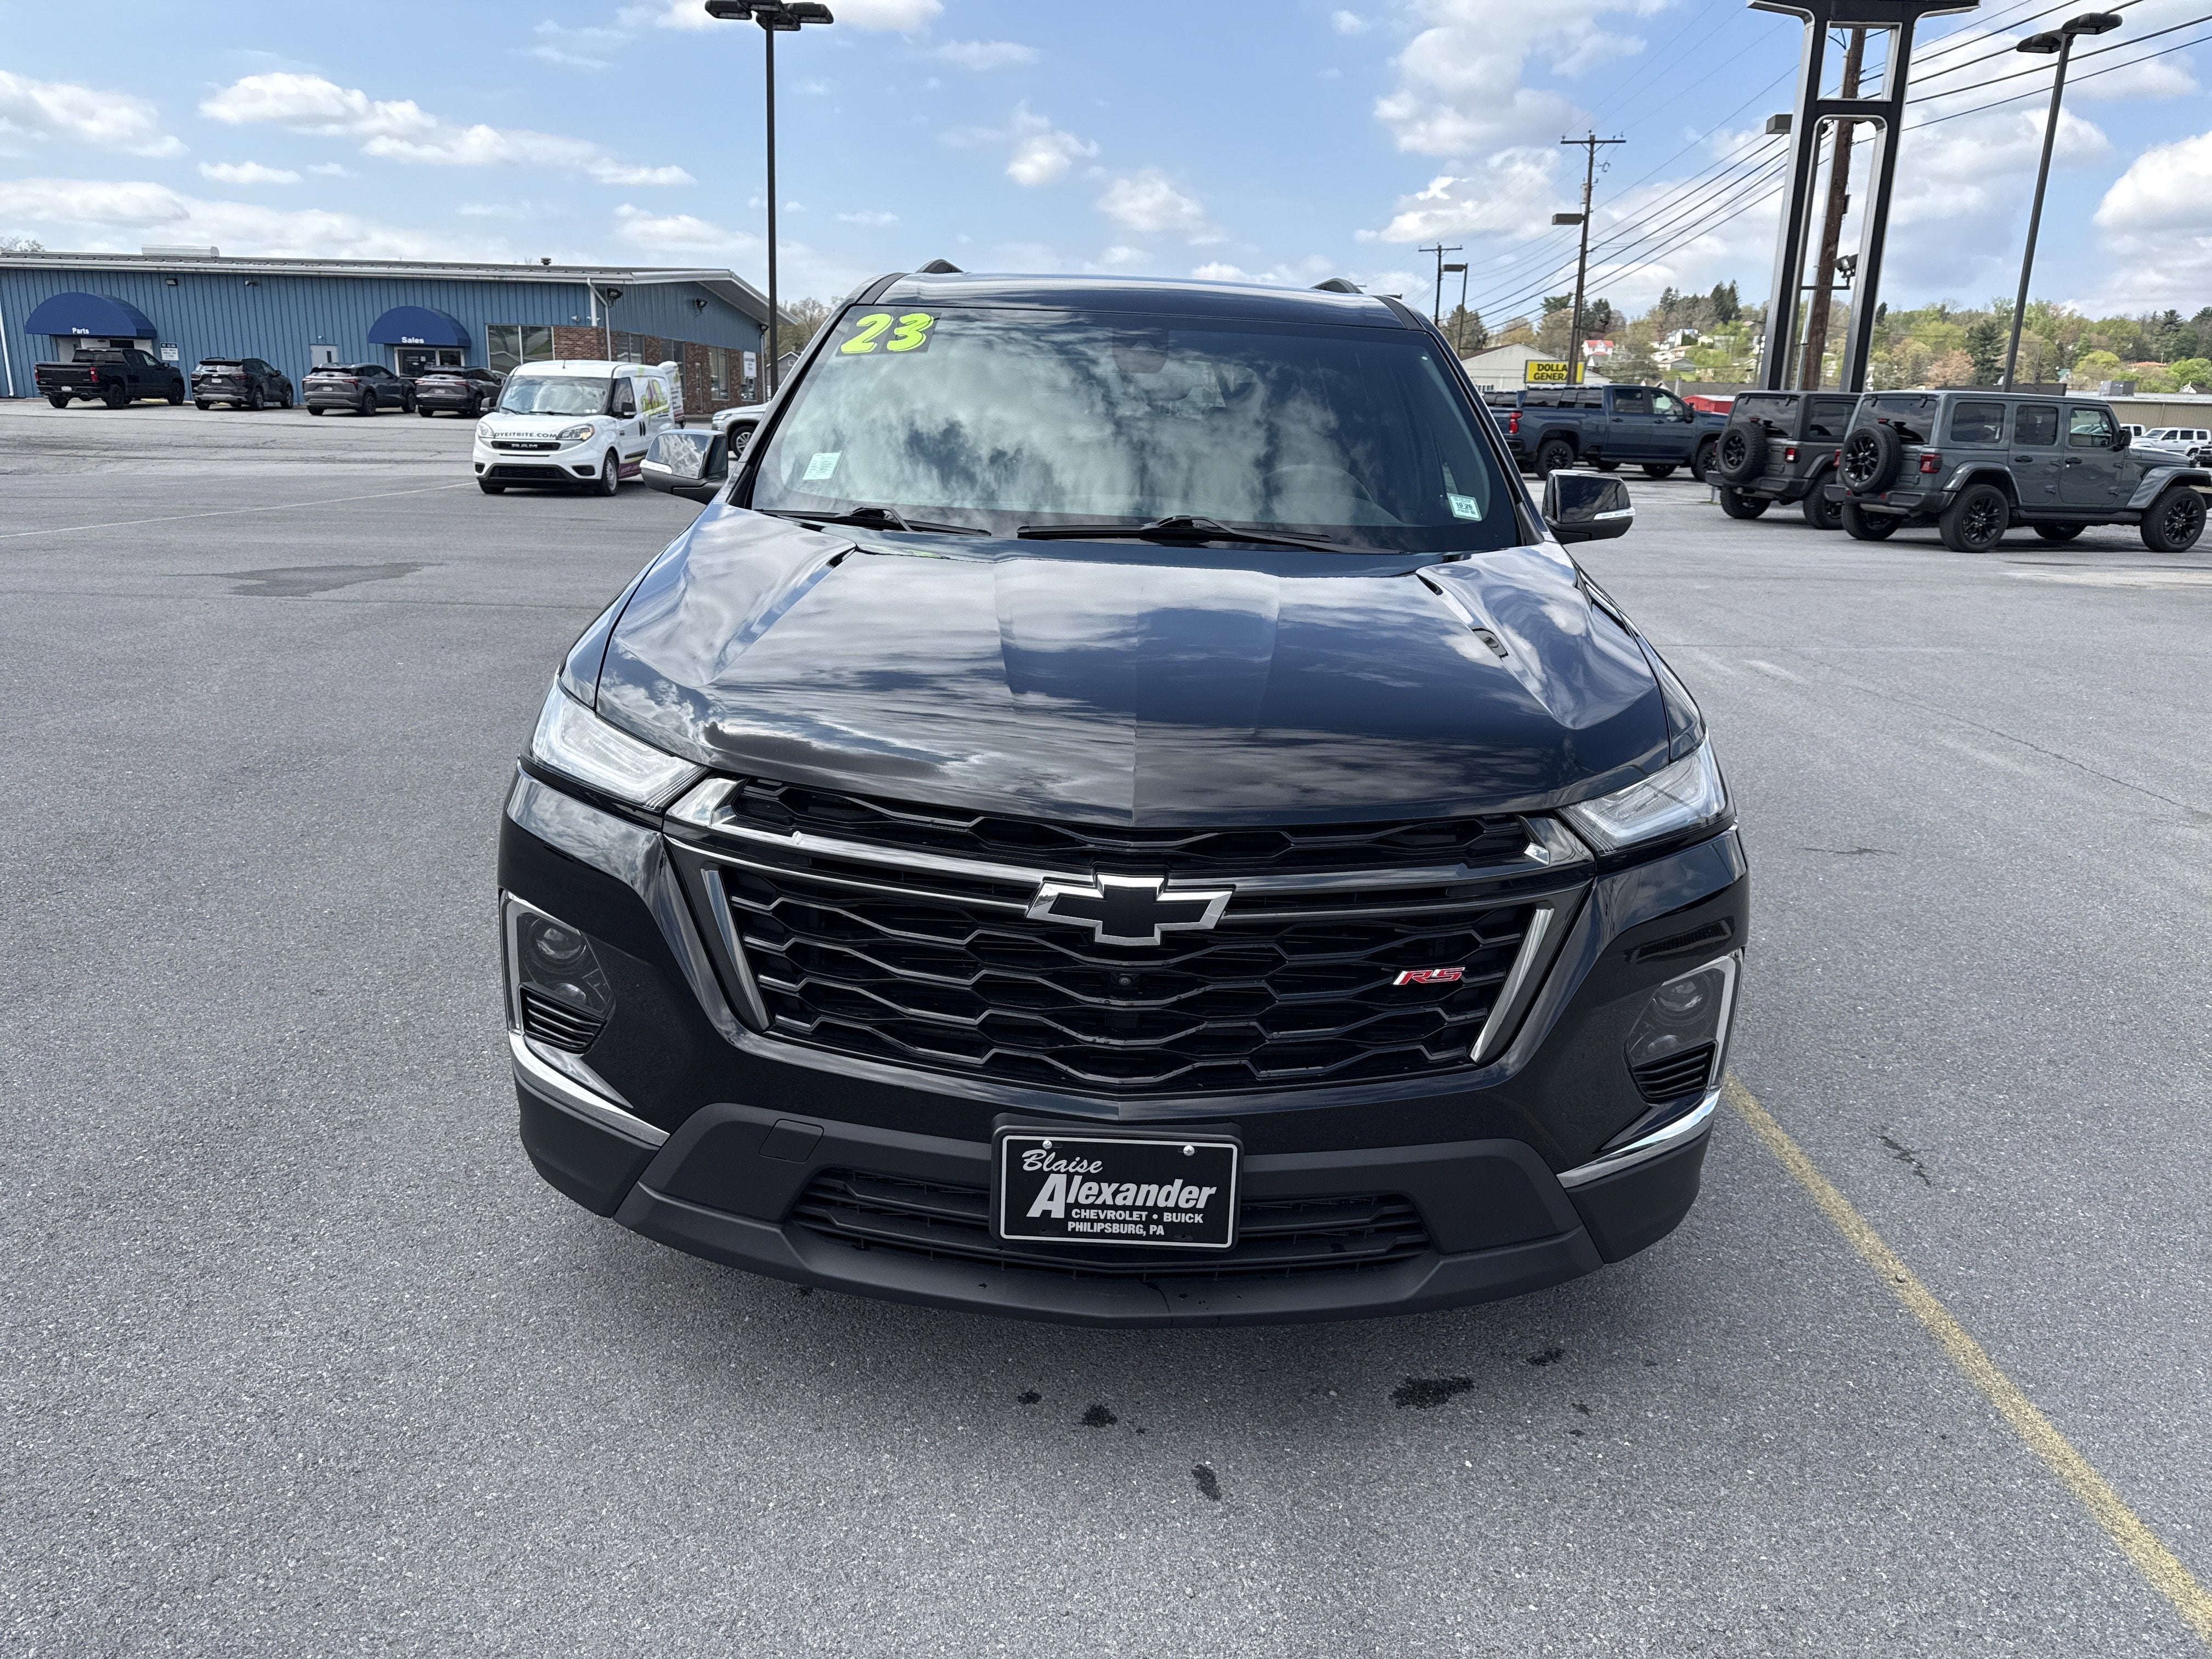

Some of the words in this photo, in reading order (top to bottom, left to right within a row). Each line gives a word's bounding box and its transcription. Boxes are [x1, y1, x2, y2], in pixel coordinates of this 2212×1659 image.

[840, 313, 934, 354] 23
[1392, 967, 1466, 985] RS
[1022, 1149, 1103, 1173] Blaise
[1026, 1173, 1217, 1218] Alexander
[1071, 1209, 1148, 1221] CHEVROLET
[1163, 1212, 1204, 1223] BUICK
[1068, 1221, 1147, 1237] PHILIPSBURG,
[1149, 1224, 1165, 1235] PA
